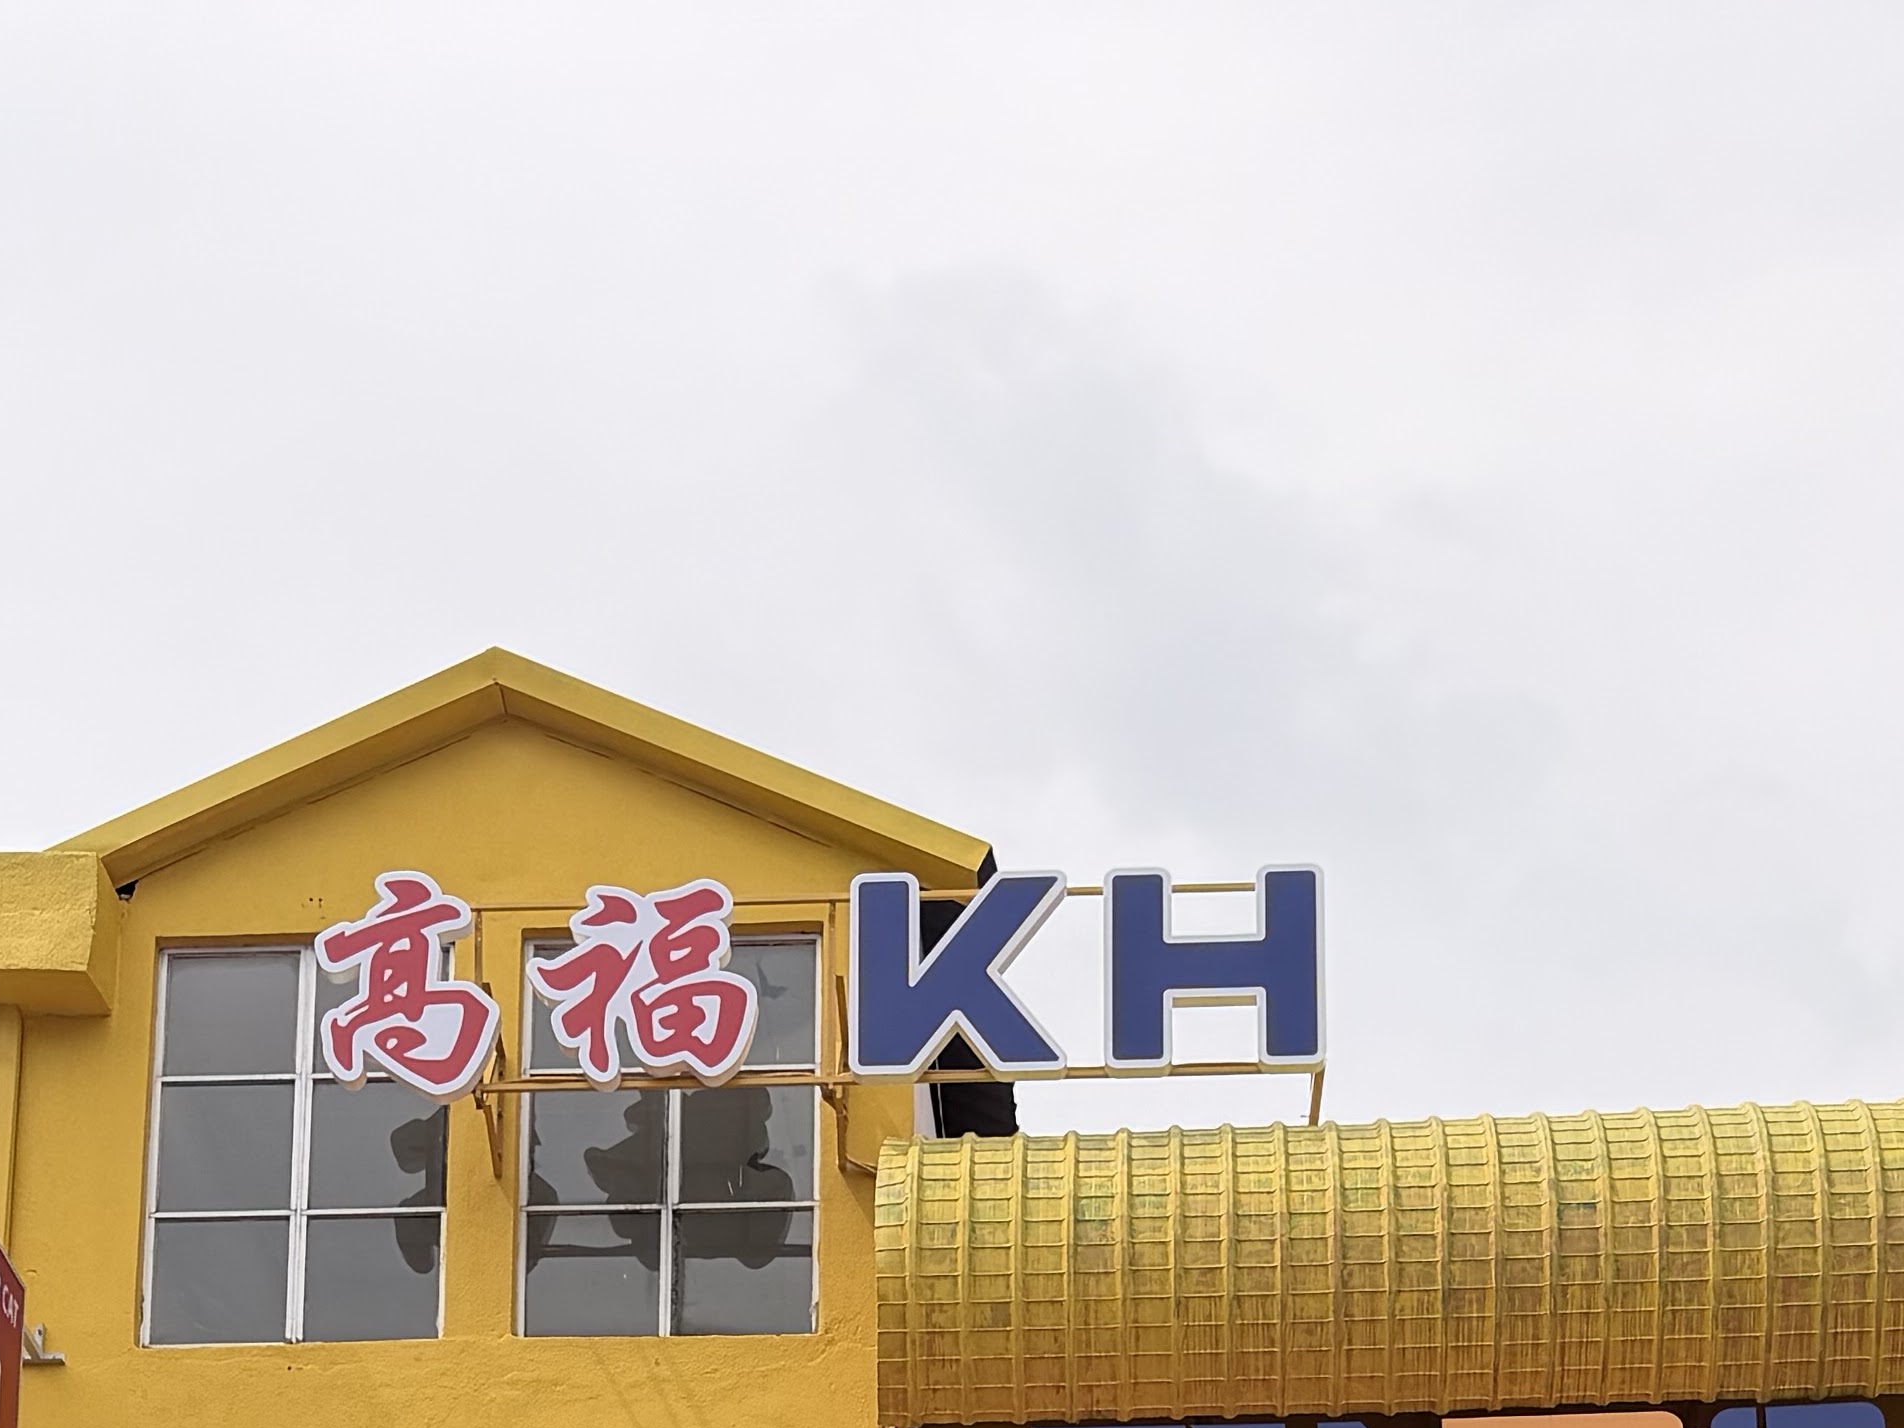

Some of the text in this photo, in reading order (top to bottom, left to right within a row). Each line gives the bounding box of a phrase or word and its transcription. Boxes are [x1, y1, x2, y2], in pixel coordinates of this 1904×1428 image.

[316, 870, 758, 1097] 高福
[849, 864, 1325, 1079] KH
[2, 1284, 19, 1328] CAT
